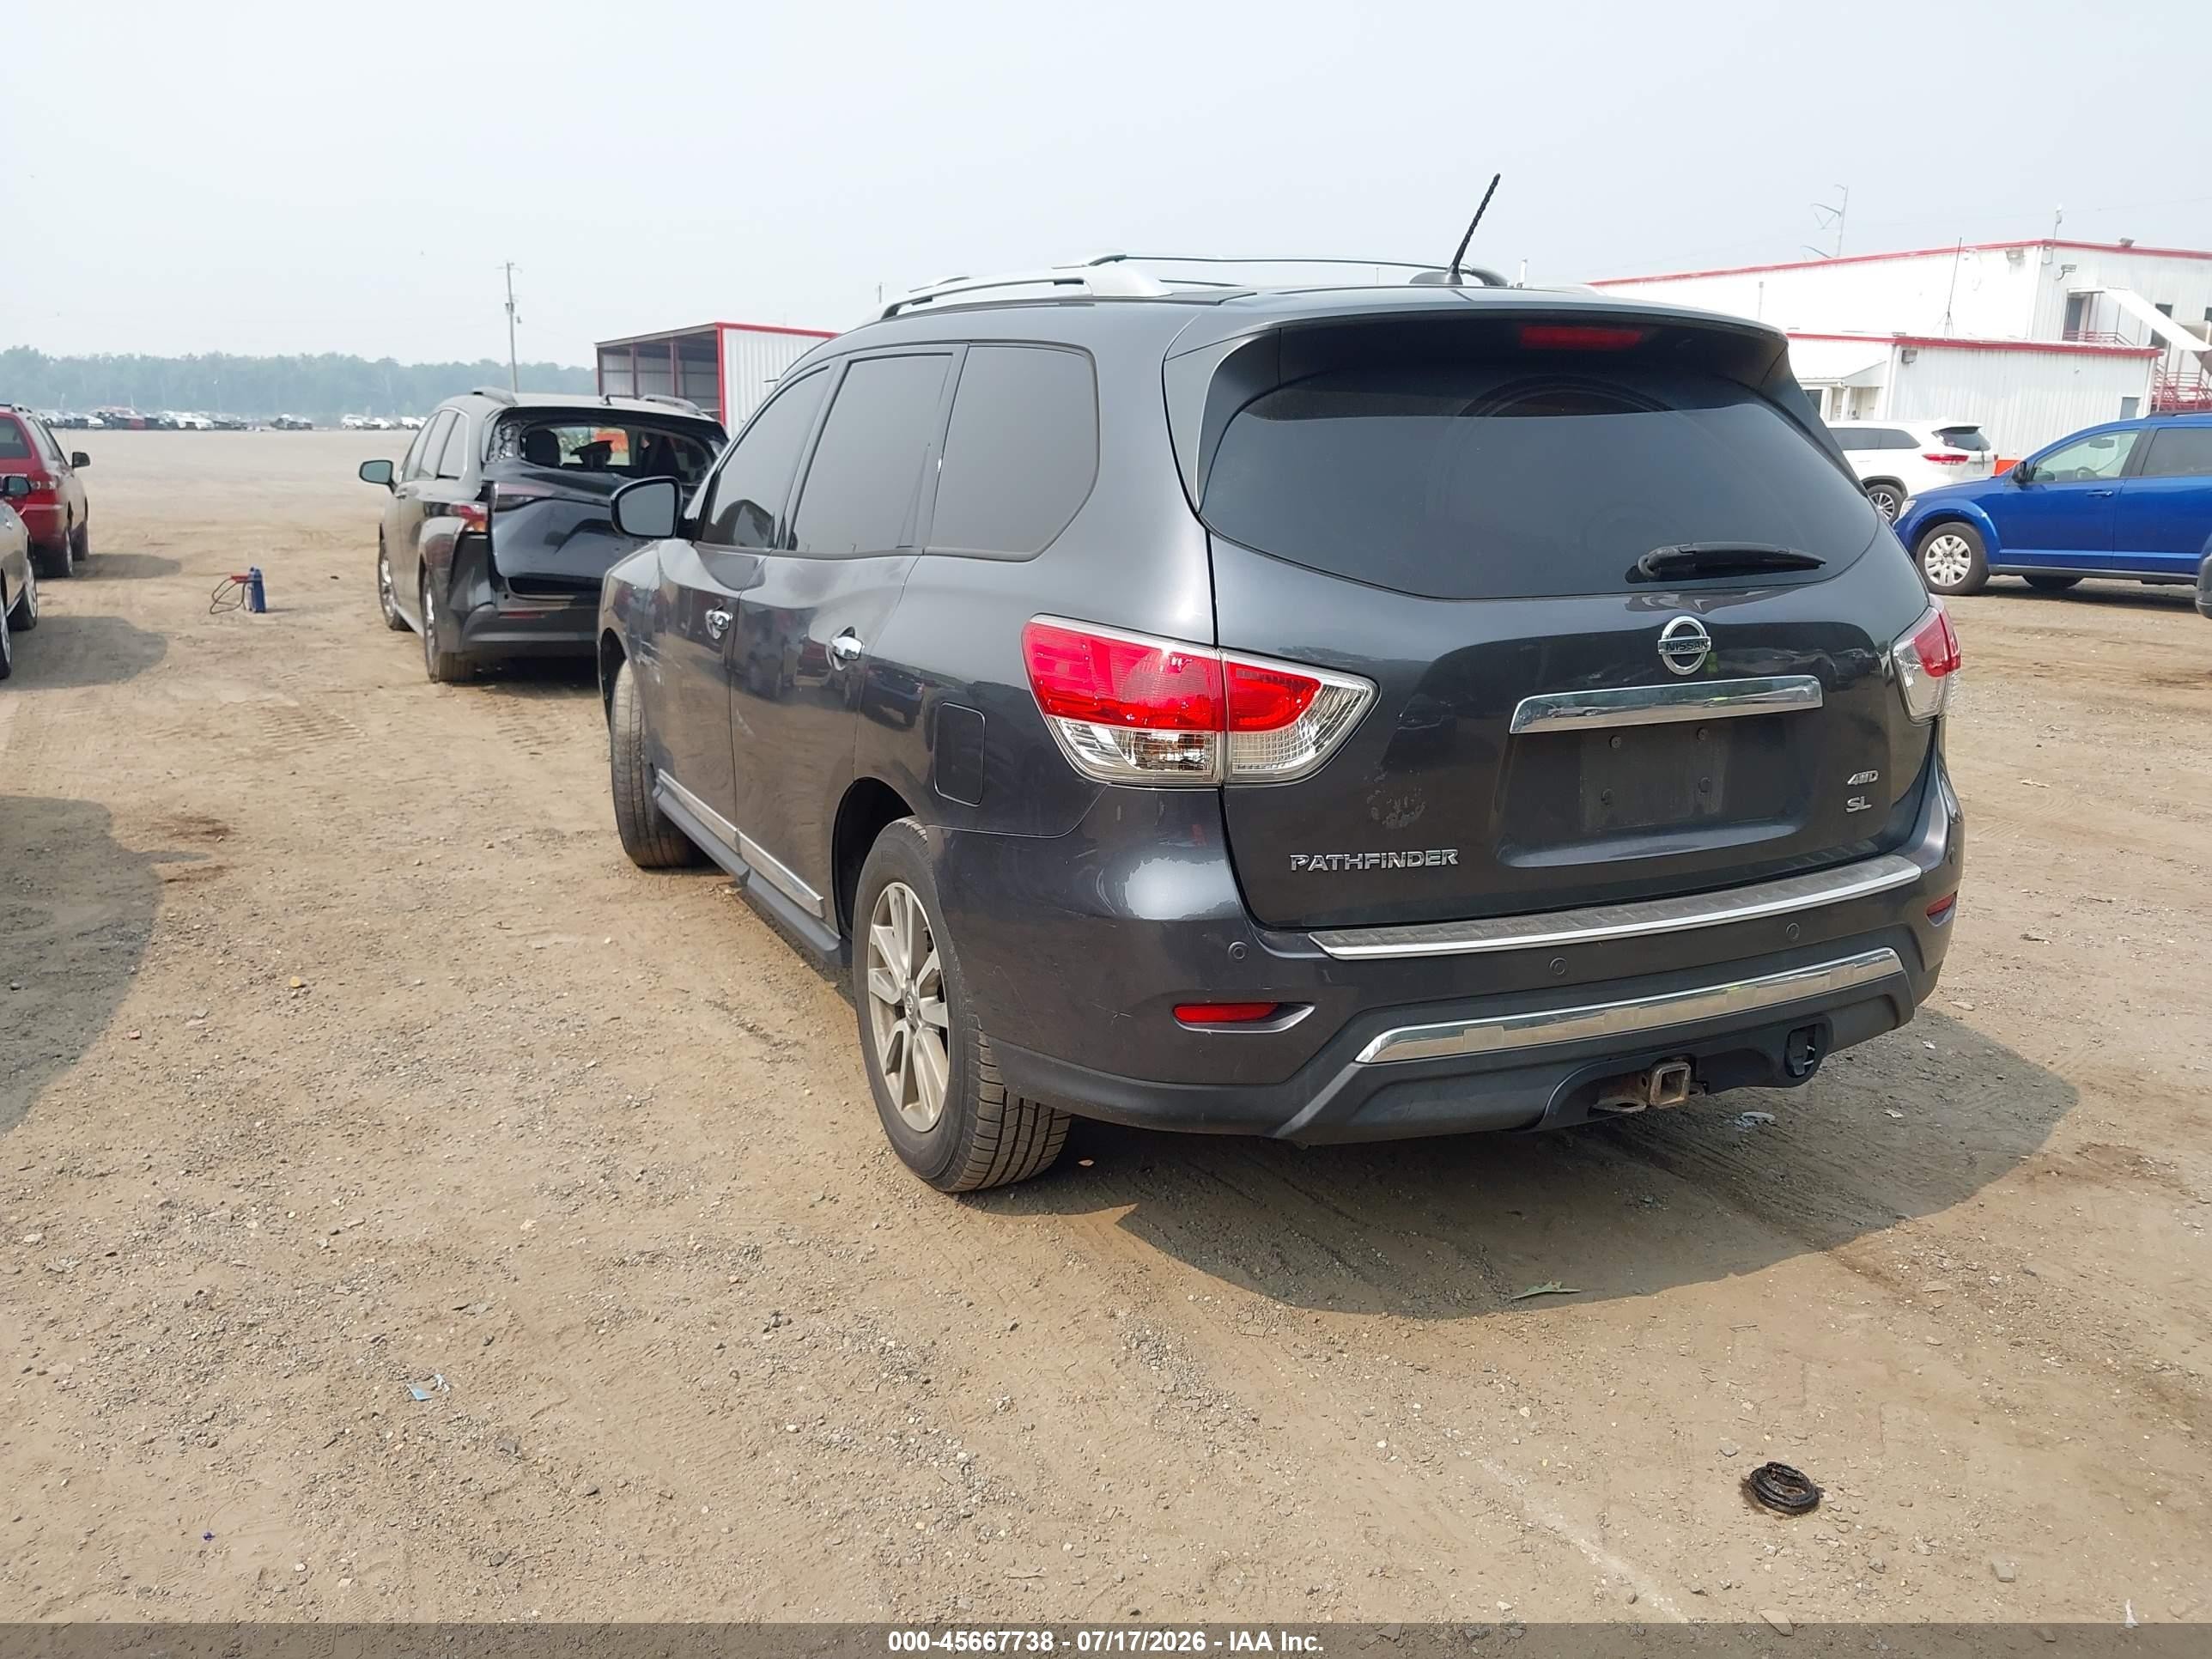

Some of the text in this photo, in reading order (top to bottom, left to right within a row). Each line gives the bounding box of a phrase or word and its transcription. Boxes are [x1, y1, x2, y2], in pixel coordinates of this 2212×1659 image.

[1666, 640, 1708, 651] NISSAN
[1847, 769, 1879, 785] 4WD
[1846, 795, 1873, 813] SL
[1290, 848, 1459, 872] PATHFINDER
